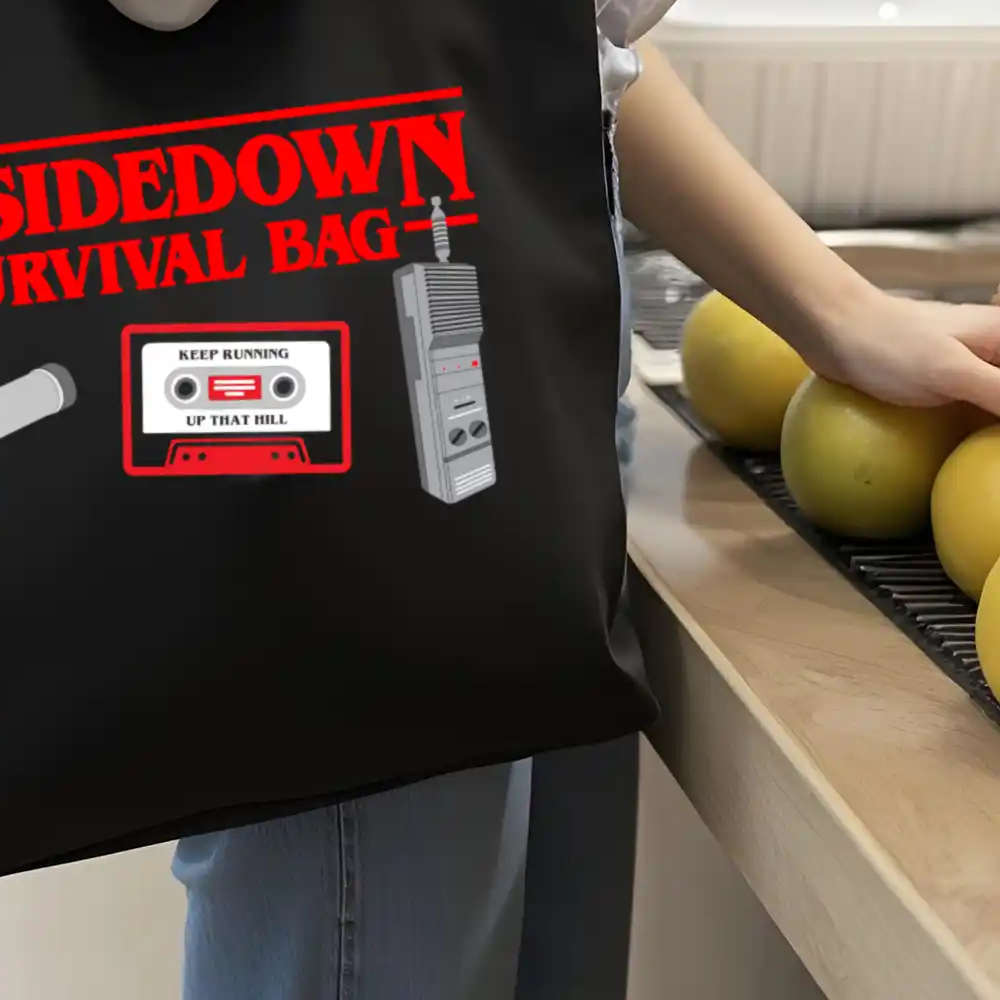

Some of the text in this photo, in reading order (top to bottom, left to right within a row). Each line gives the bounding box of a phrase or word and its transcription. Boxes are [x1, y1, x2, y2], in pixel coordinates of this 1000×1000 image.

[265, 208, 400, 275] BAG
[179, 348, 289, 360] KEEP RUNNING
[186, 414, 288, 426] UP THAT HILL
